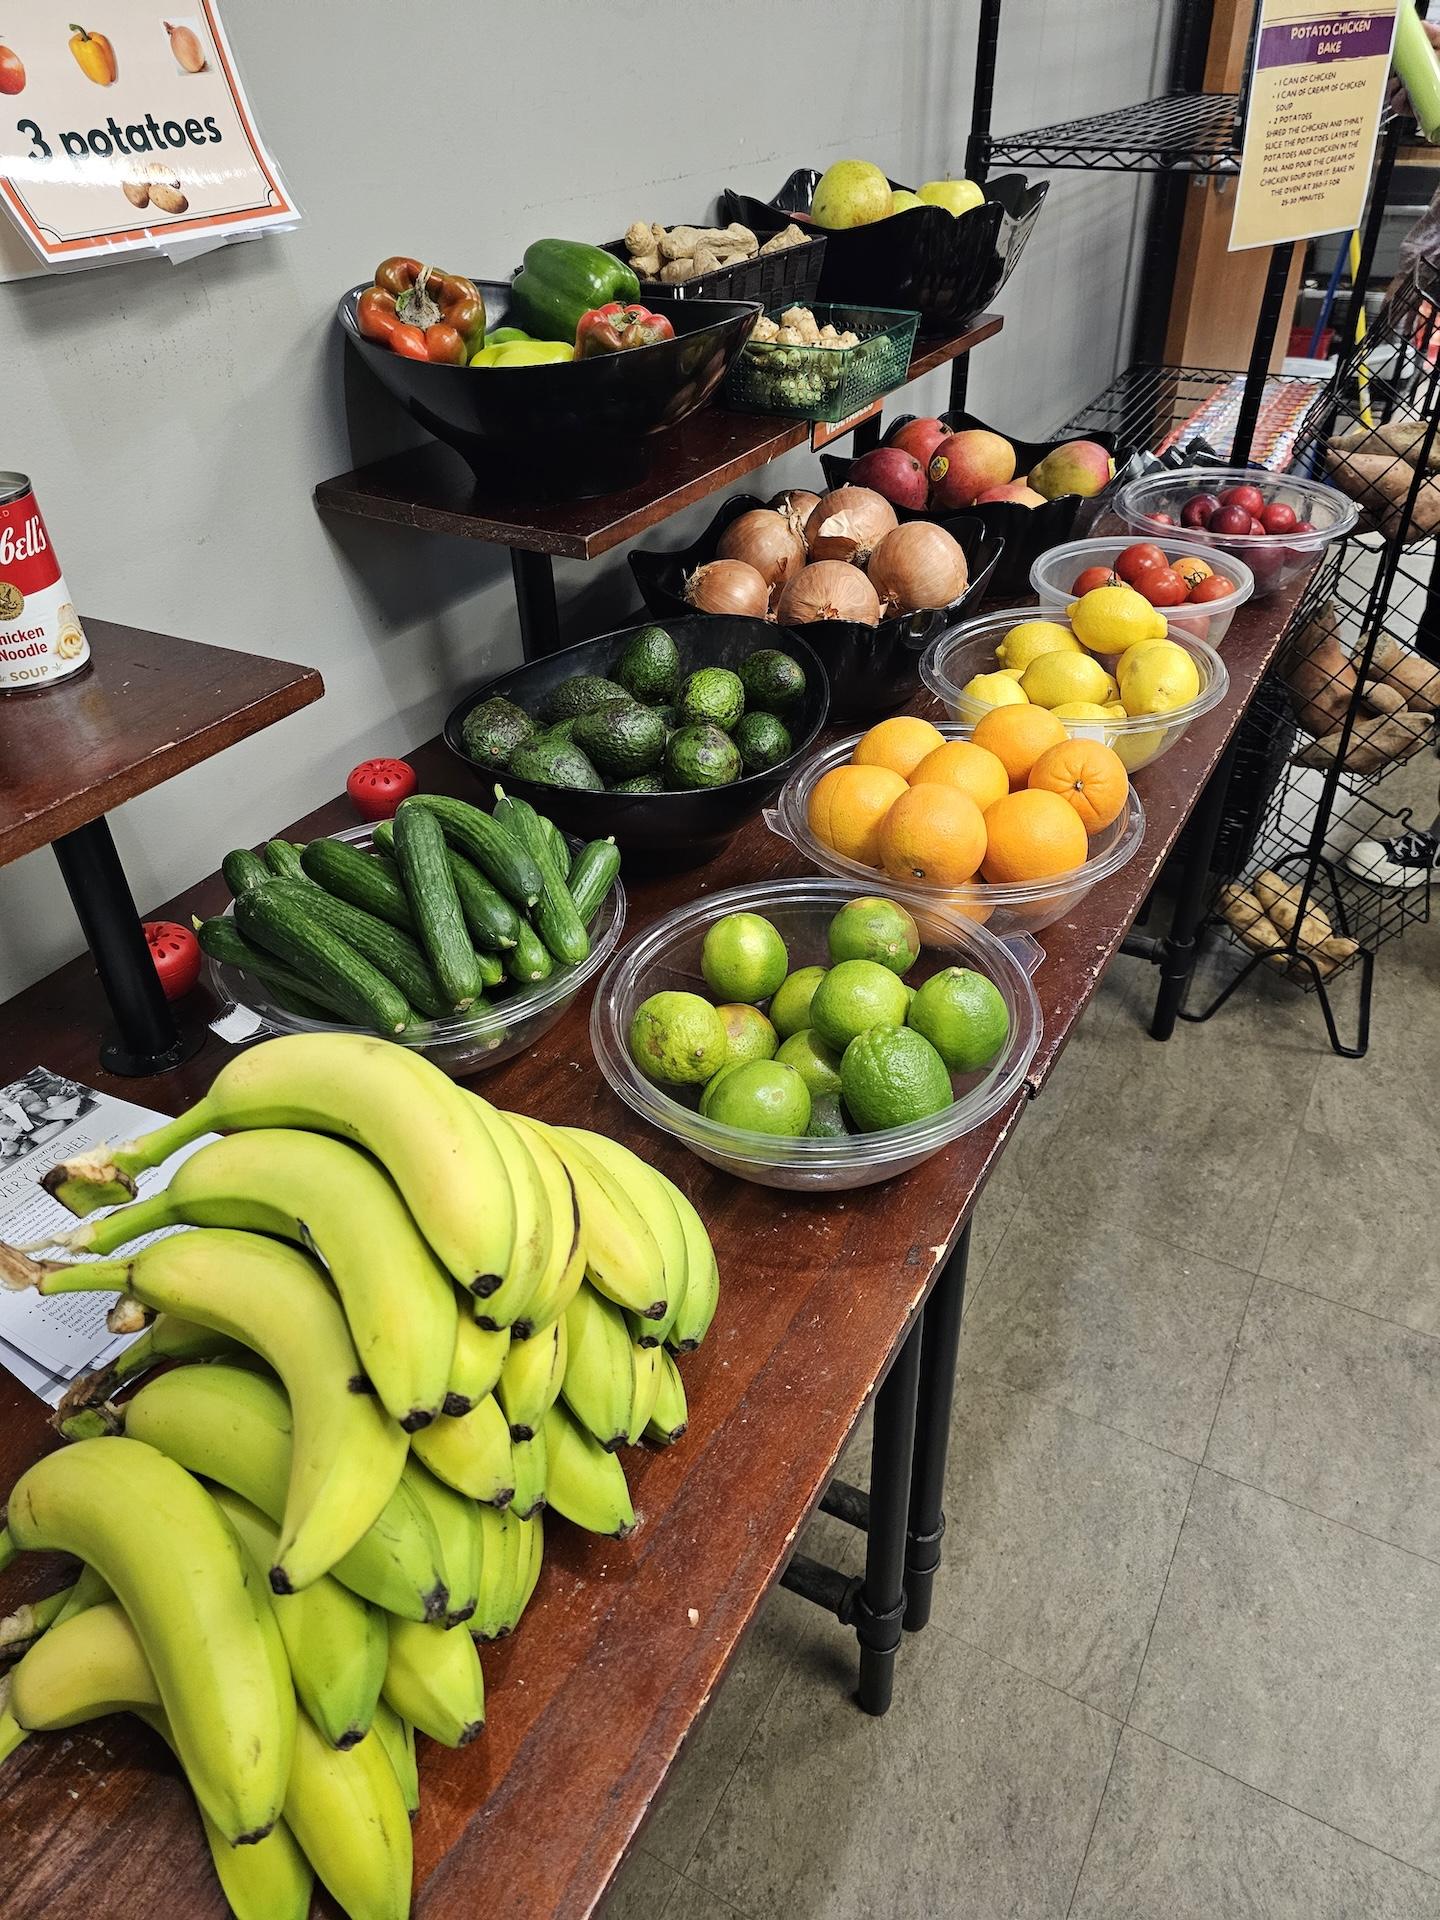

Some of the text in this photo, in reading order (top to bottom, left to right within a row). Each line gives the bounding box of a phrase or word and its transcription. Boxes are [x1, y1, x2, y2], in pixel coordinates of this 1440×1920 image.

[1291, 20, 1372, 40] POTATO CHICKEN
[1317, 41, 1342, 55] BAKE
[1283, 77, 1299, 86] CAN
[1300, 75, 1308, 83] OF
[1310, 72, 1337, 83] CHICKEN
[1281, 90, 1297, 99] CAN
[1298, 88, 1306, 96] OF
[1308, 85, 1330, 95] CREAM
[1331, 83, 1339, 91] OF
[1340, 80, 1367, 91] CHICKEN
[1276, 102, 1294, 112] SOUP
[1266, 116, 1364, 138] SHRED THE CHICKEN AND THINLY
[1279, 112, 1312, 124] POTATOES
[17, 114, 223, 164] 3 potatoes
[1265, 141, 1283, 151] SLICE
[1284, 139, 1296, 147] THE
[1331, 131, 1349, 140] LAYER
[1351, 128, 1361, 136] THE
[1264, 151, 1297, 162] POTATOES
[1313, 144, 1339, 155] CHICKEN
[1348, 140, 1359, 148] THE
[1280, 163, 1295, 171] AND
[1296, 160, 1312, 169] POUR
[1314, 158, 1325, 166] THE
[1326, 154, 1347, 165] CREAM
[1260, 176, 1289, 187] CHICKEN
[1291, 172, 1306, 182] SOUP
[1307, 170, 1323, 178] OVER
[1332, 166, 1347, 175] BAKE
[1271, 188, 1283, 197] THE
[1284, 185, 1301, 194] OVEN
[1302, 183, 1311, 191] AT
[1329, 178, 1340, 186] FOR
[1298, 193, 1325, 203] MINUTES
[10, 665, 49, 682] SOUP
[1, 1142, 61, 1181] Food Initiatives
[33, 1135, 92, 1175] KITCHEN
